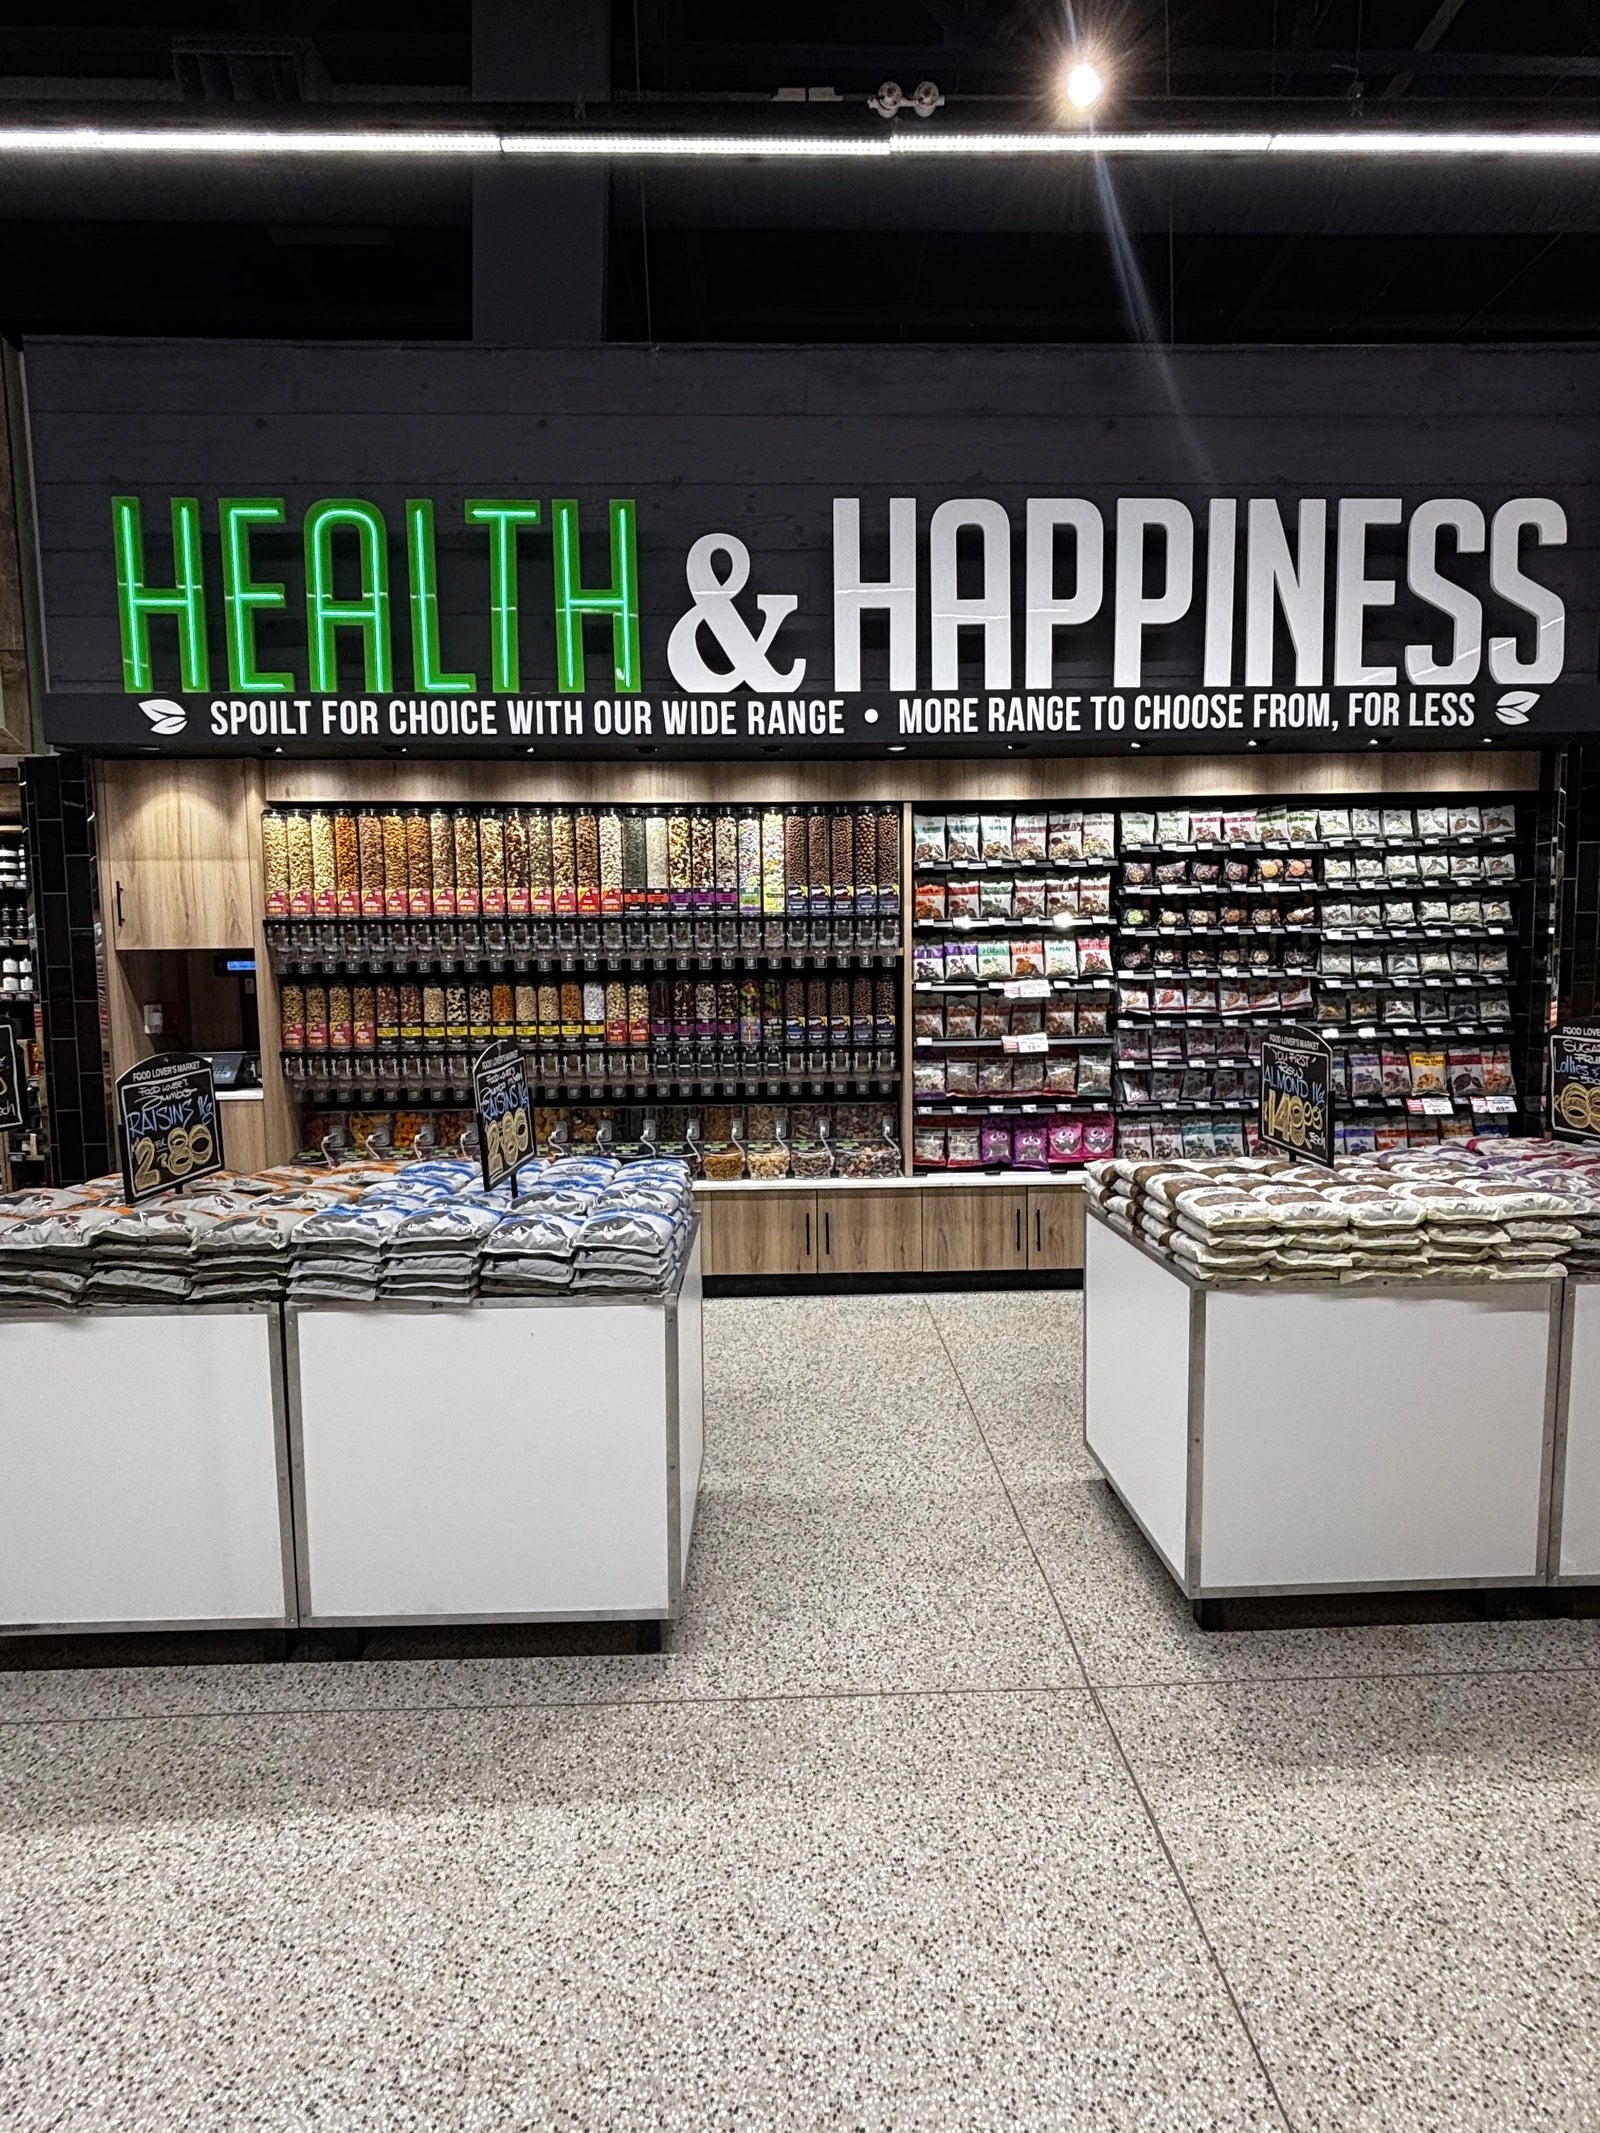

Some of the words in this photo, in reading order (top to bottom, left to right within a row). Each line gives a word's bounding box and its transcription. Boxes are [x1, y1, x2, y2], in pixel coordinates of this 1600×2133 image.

[110, 496, 642, 694] HEALTH
[667, 533, 807, 694] &
[833, 497, 1568, 693] HAPPINESS
[210, 700, 312, 736] SPOILT
[322, 700, 379, 735] FOR
[389, 699, 498, 735] CHOICE
[506, 700, 583, 735] WITH
[593, 700, 652, 735] OUR
[661, 700, 737, 735] WIDE
[747, 699, 845, 735] RANGE
[899, 697, 979, 734] MORE
[988, 695, 1082, 732] RANGE
[1090, 694, 1126, 730] TO
[1134, 693, 1244, 730] CHOOSE
[1252, 692, 1339, 732] FROM,
[1348, 691, 1401, 728] FOR
[1408, 691, 1475, 727] LESS
[1269, 1034, 1282, 1044] FOOD
[1562, 1026, 1582, 1036] FOOD
[133, 1071, 151, 1081] FOOD
[177, 1061, 200, 1072] MARKET
[1263, 1064, 1309, 1098] ALMOND
[126, 1098, 194, 1137] RAISINS
[480, 1085, 518, 1121] RAISINS
[134, 1136, 161, 1191] 2
[487, 1119, 504, 1177] 2
